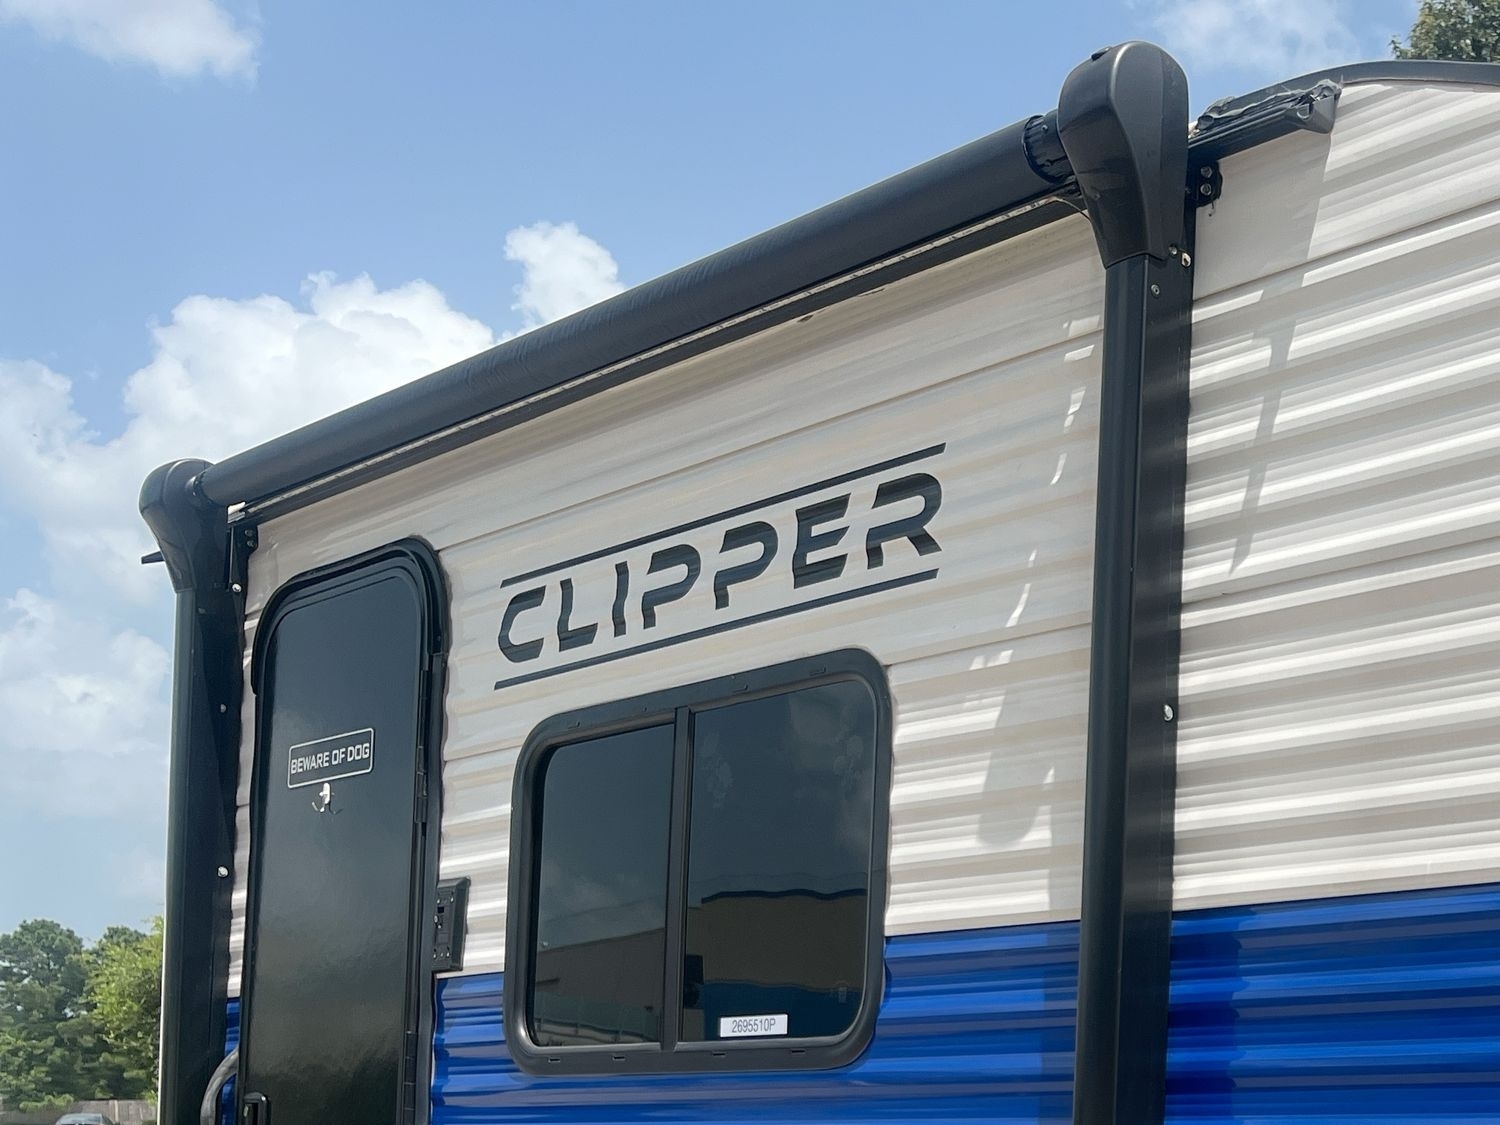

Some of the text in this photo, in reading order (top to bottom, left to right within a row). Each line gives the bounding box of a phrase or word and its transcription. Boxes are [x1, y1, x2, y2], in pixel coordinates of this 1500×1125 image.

[498, 472, 943, 663] CLIPPER
[291, 743, 370, 774] BEWARE OF DOG
[731, 1018, 776, 1033] 2695510P
